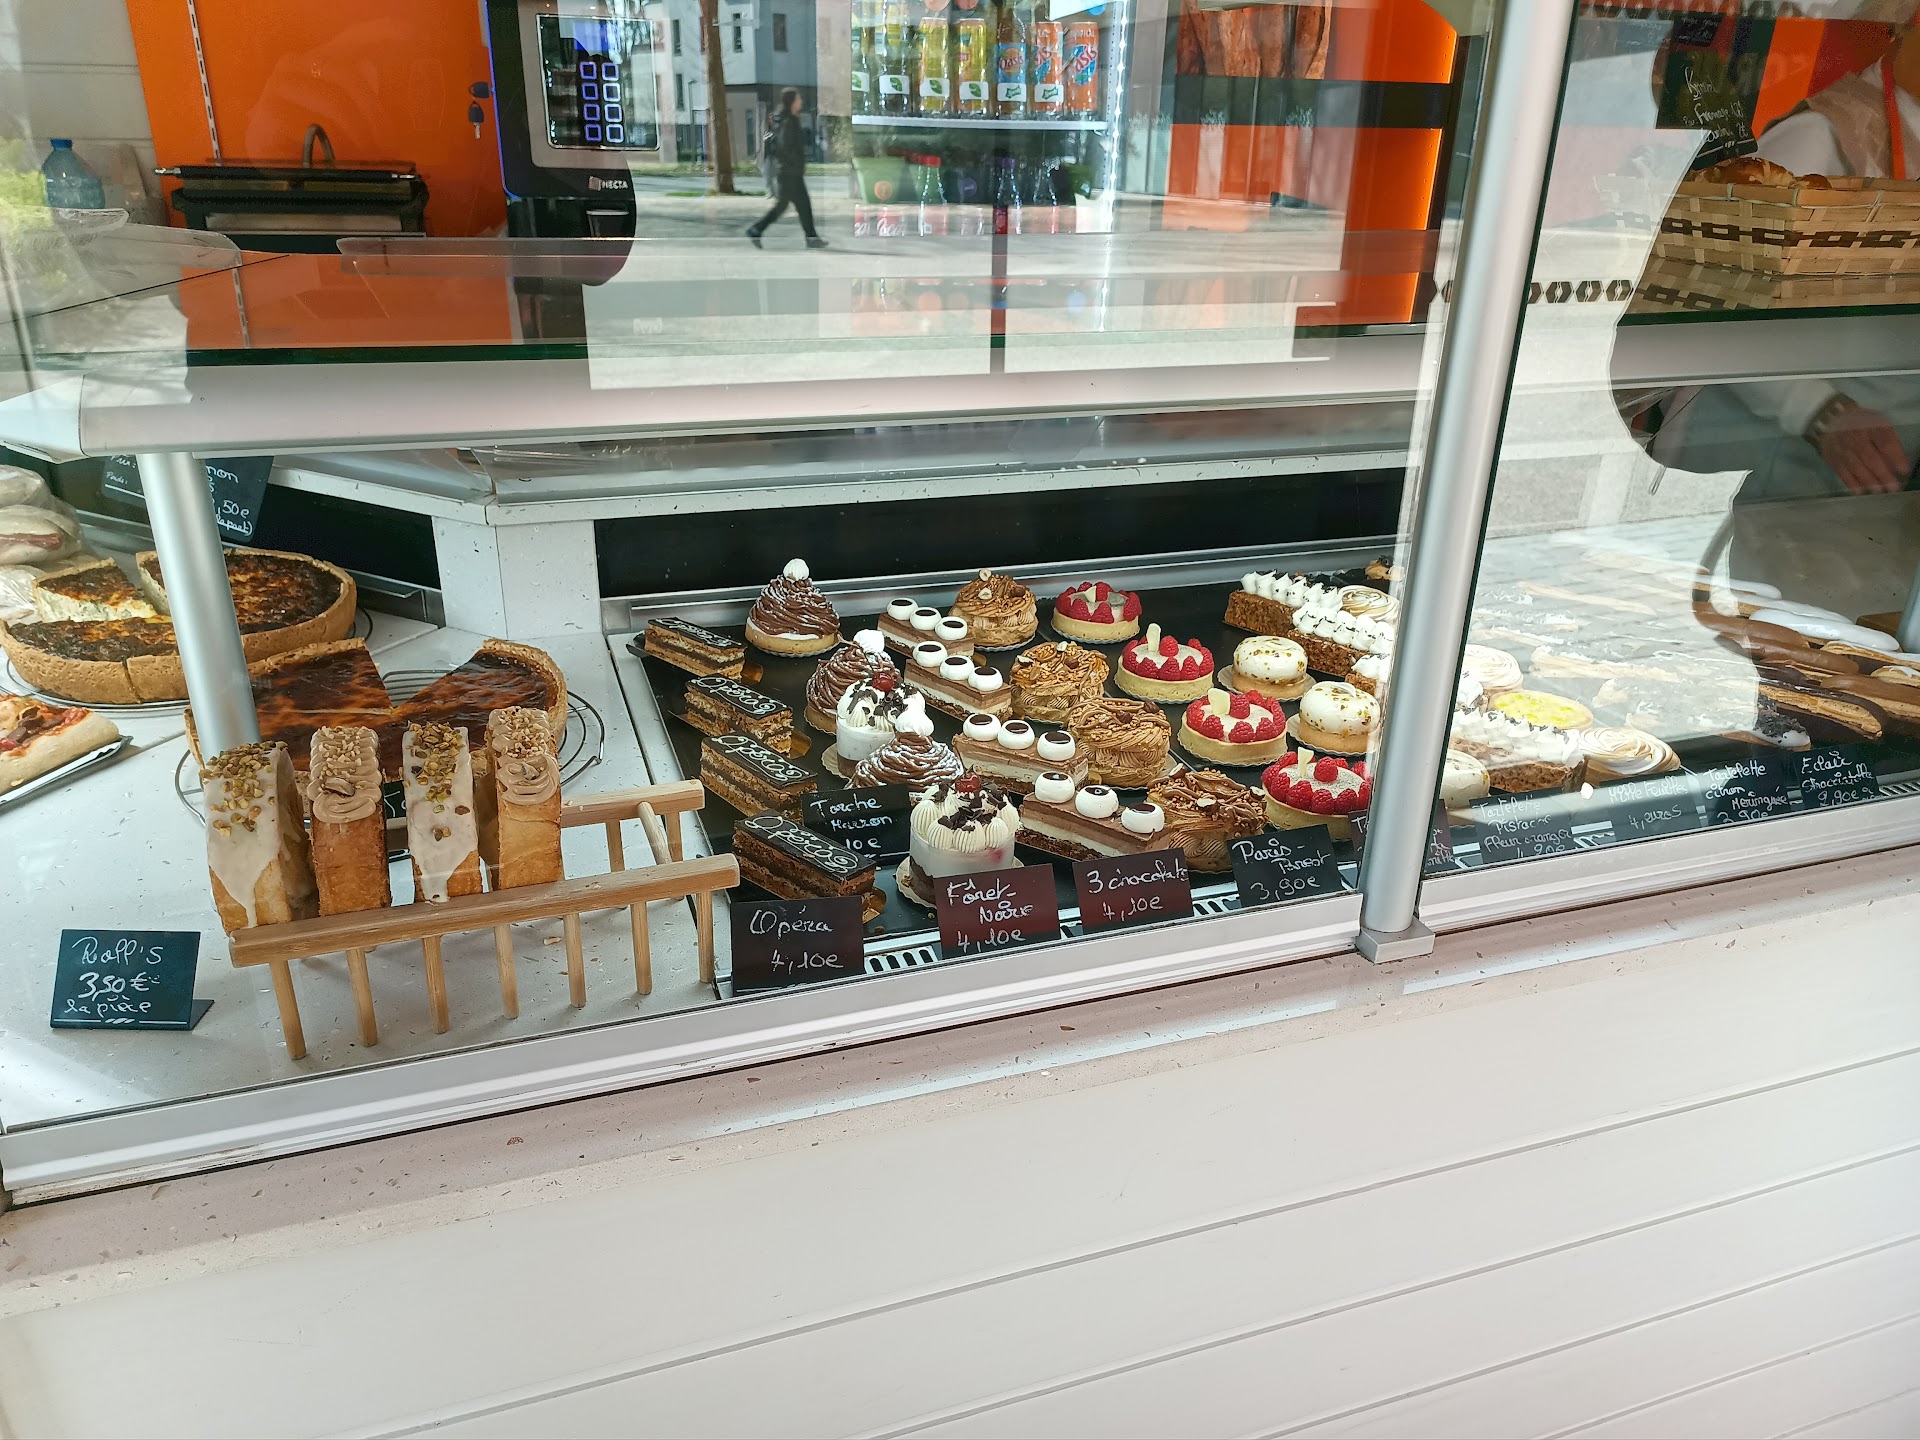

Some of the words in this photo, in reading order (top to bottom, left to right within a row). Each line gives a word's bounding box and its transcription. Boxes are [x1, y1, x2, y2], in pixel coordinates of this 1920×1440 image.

[999, 55, 1024, 71] Oasis
[1087, 870, 1104, 894] 3
[1250, 876, 1321, 900] 3,90e
[1102, 896, 1163, 922] 4,10e
[749, 904, 834, 940] Opéra
[957, 928, 1026, 954] 4,10e
[771, 949, 844, 975] 4,10e
[64, 998, 91, 1014] la
